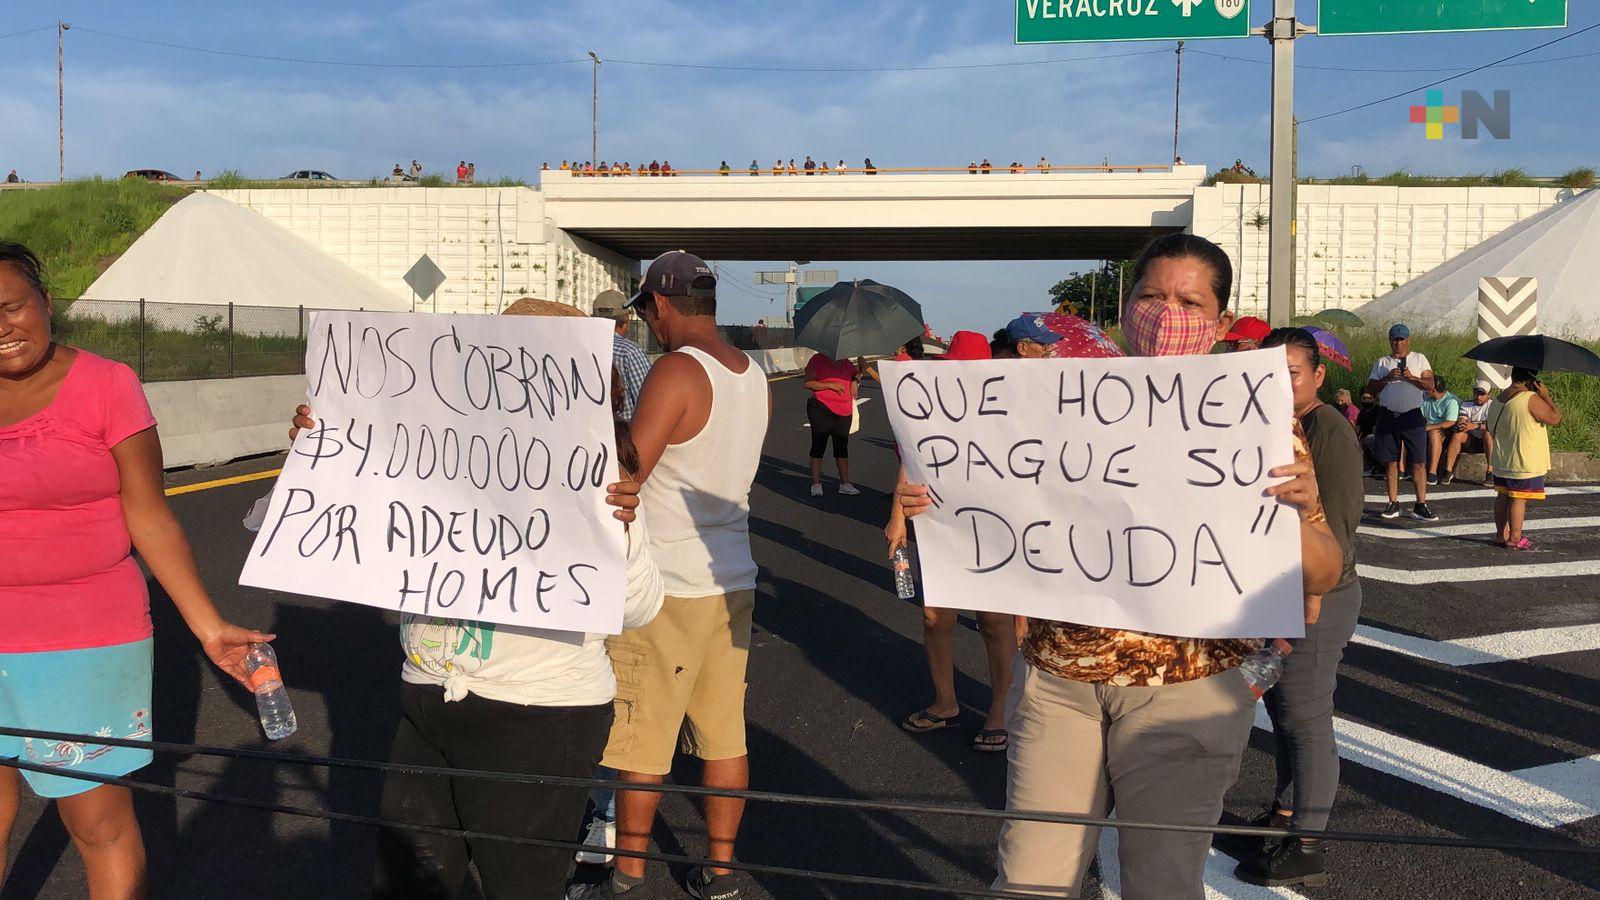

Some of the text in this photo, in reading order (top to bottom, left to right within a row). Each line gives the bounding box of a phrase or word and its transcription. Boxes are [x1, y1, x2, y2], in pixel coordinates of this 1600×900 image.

[1026, 0, 1159, 19] VERACRUZ
[315, 322, 607, 420] NOS COBRAN
[896, 370, 1274, 432] QUE HOMEX
[917, 435, 1264, 488] PAGUE SU
[260, 488, 551, 565] POR ADEUDO
[398, 562, 598, 616] HOMES
